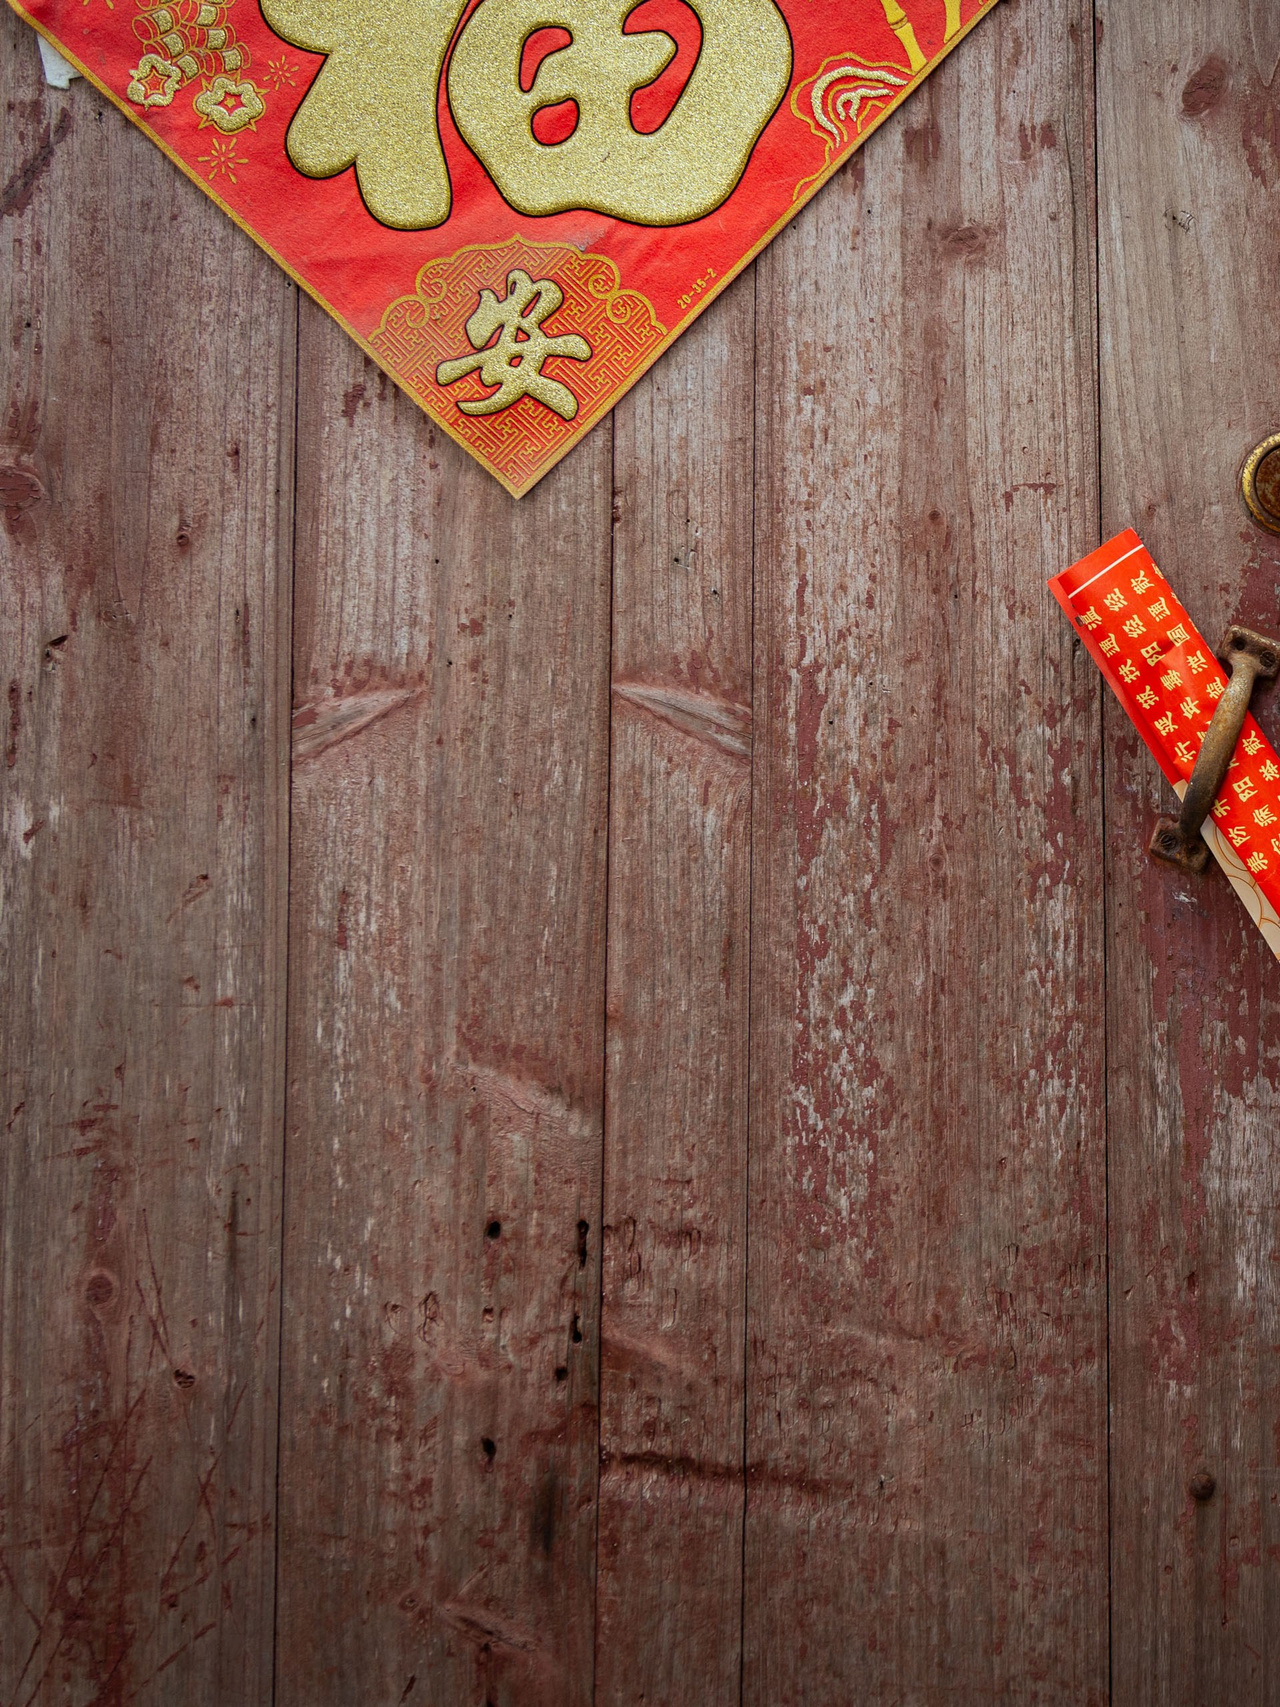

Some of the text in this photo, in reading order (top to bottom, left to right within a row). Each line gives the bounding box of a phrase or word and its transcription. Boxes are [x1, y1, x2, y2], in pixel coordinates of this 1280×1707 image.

[677, 267, 717, 309] 20-35-2
[436, 268, 592, 421] 安
[1080, 563, 1164, 630] 温经散
[1099, 592, 1182, 658] 通经通
[1118, 618, 1199, 683] 扶阳固
[1136, 646, 1211, 709] 拔毒泄
[1154, 676, 1229, 736] 延年益
